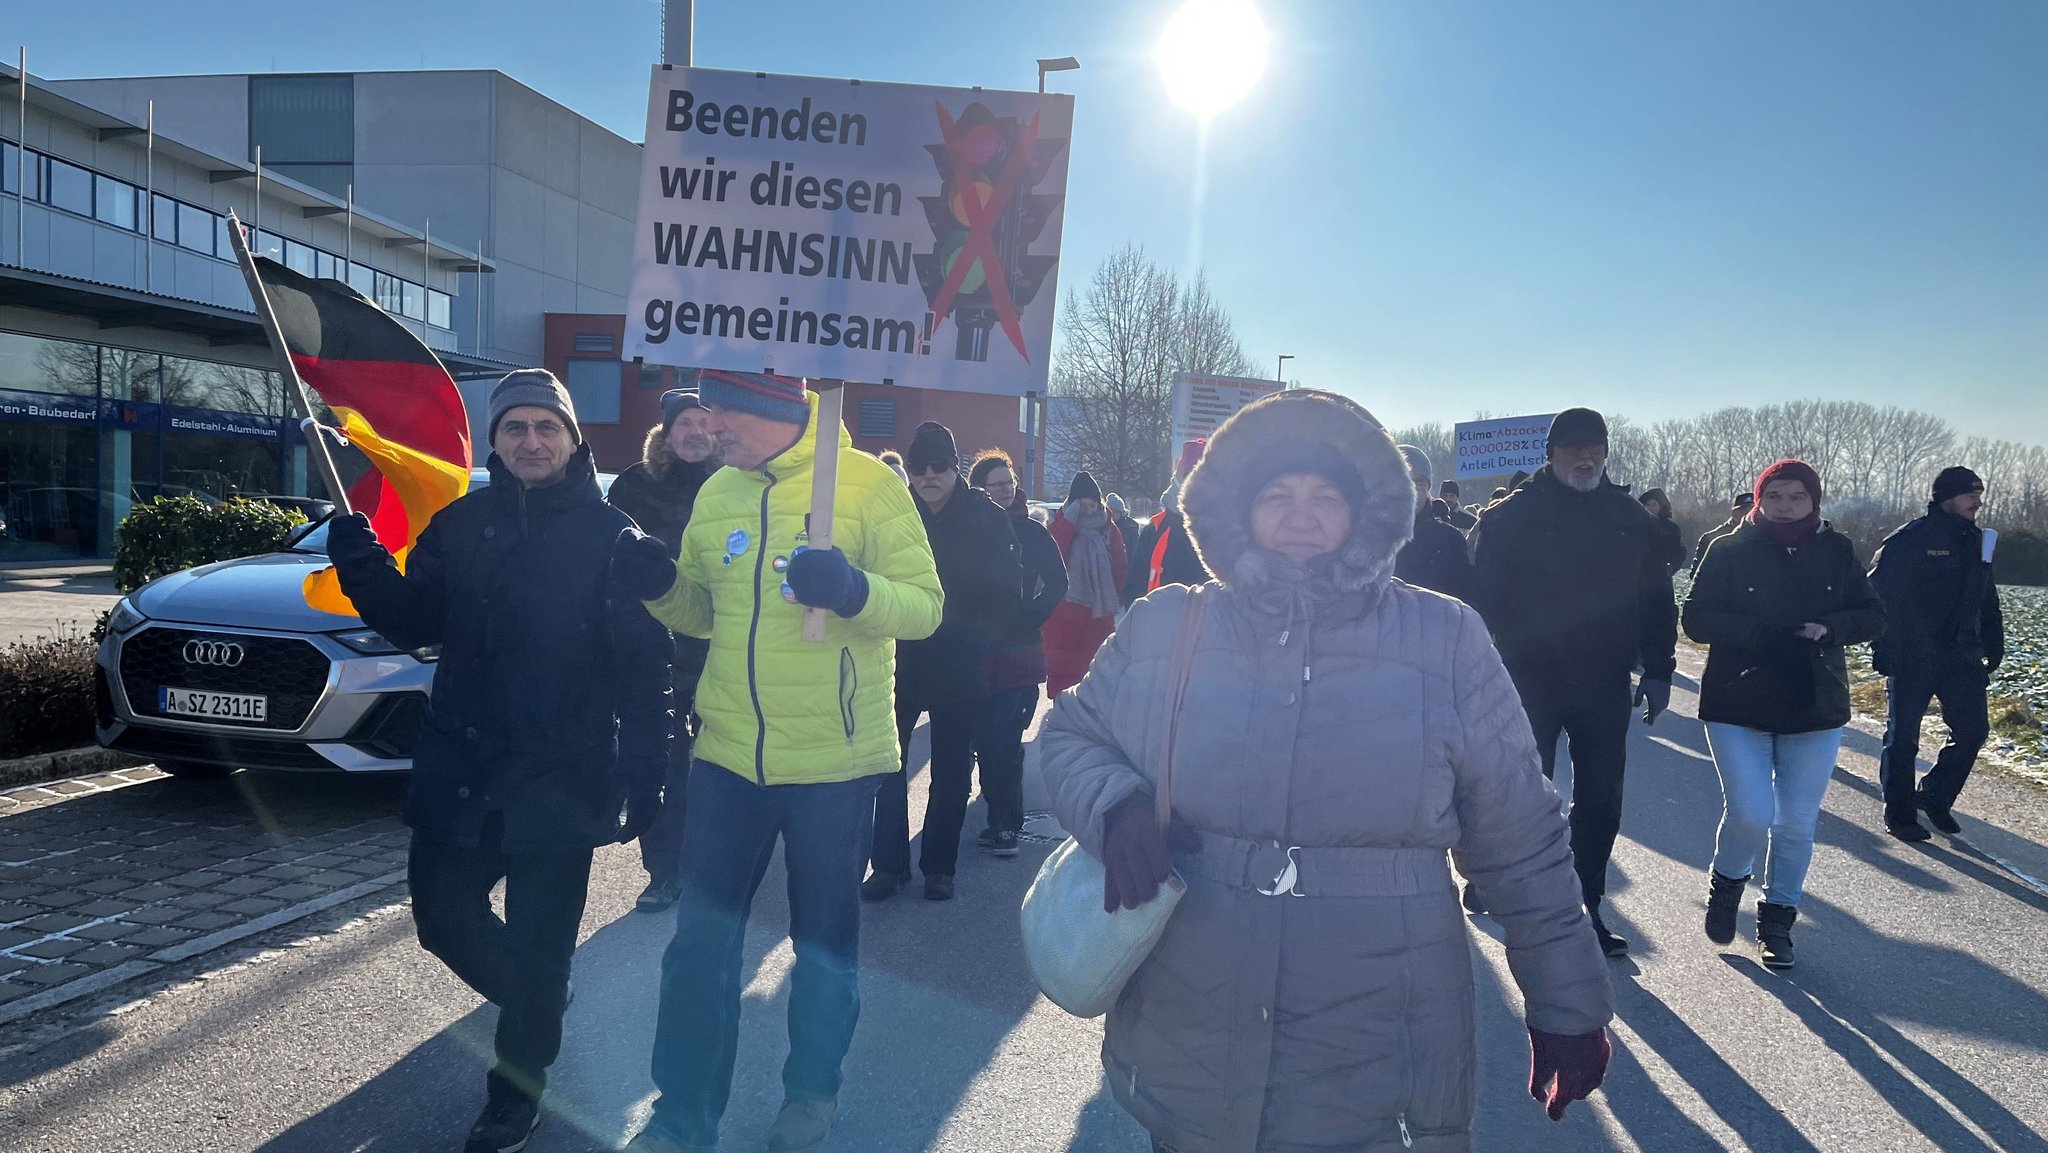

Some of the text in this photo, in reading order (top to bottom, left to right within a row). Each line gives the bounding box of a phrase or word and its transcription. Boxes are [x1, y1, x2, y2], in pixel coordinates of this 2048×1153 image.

[665, 89, 867, 146] Beenden
[659, 157, 902, 216] wir diesen
[653, 222, 913, 285] WAHNSINN
[645, 297, 935, 355] gemeinsam!
[1459, 440, 1529, 457] 0,000028%
[1461, 457, 1496, 471] Anteil
[168, 691, 263, 719] A SZ 2311E
